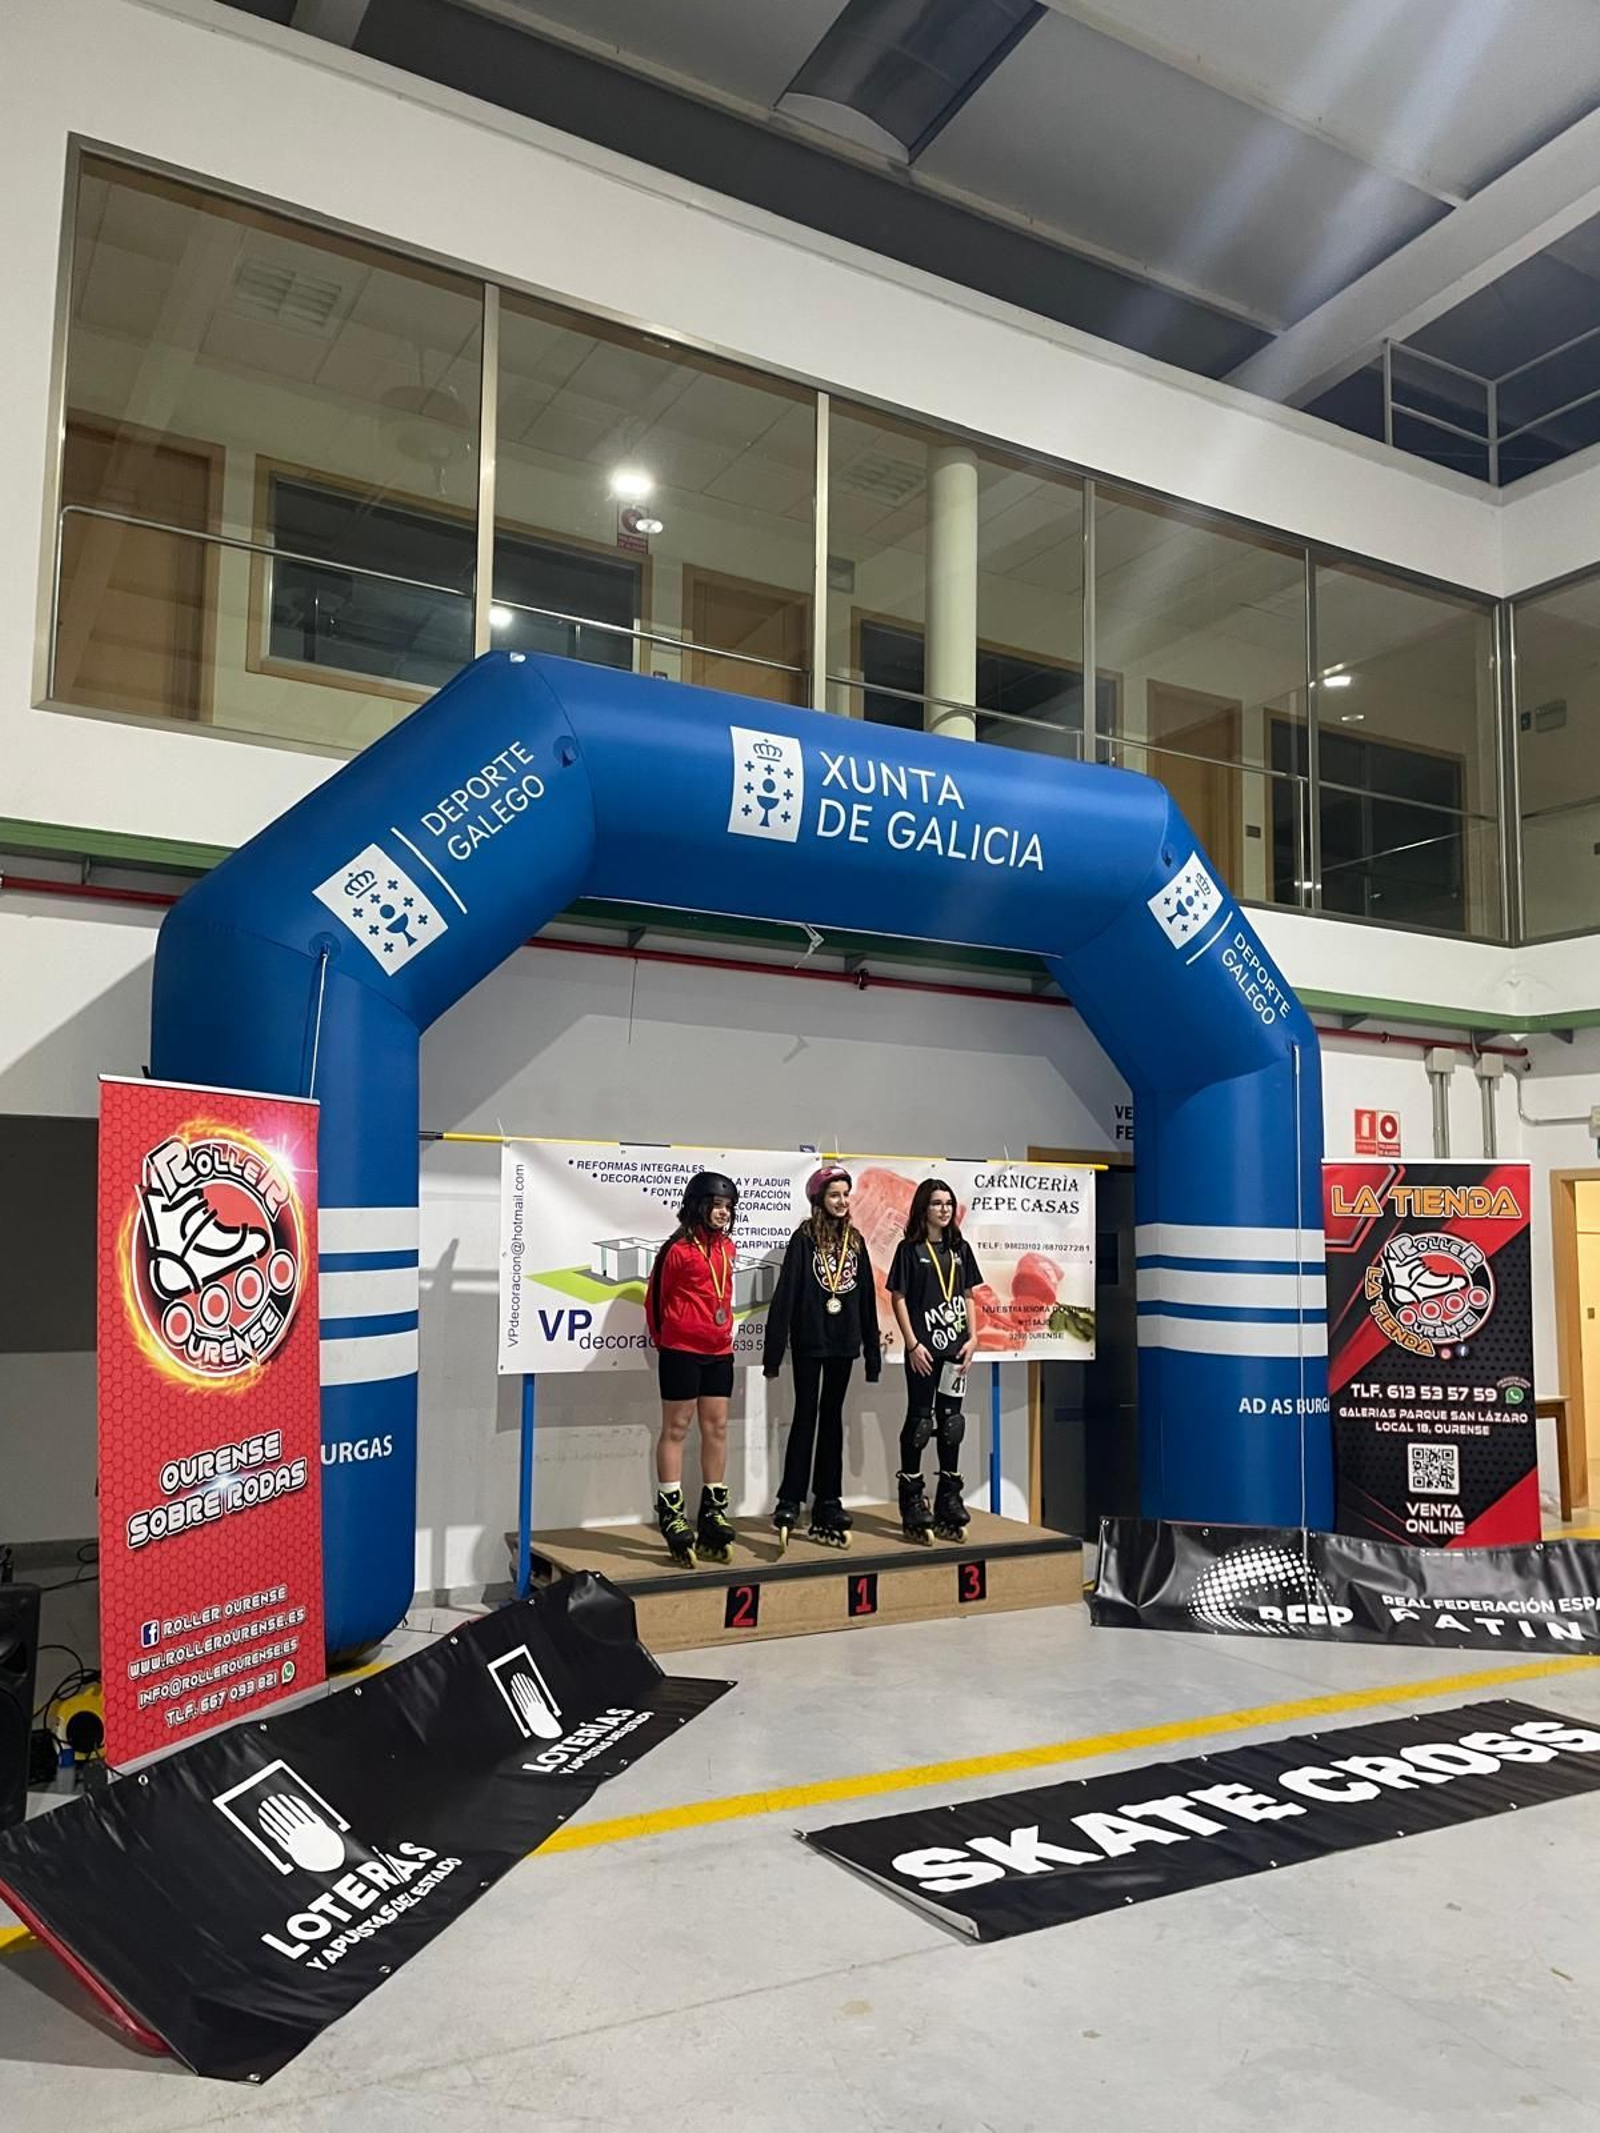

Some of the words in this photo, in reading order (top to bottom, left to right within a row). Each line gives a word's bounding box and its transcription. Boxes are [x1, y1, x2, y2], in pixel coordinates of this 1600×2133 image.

[421, 741, 534, 836] DEPORTE
[820, 751, 965, 810] XUNTA
[447, 775, 544, 860] GALEGO
[817, 798, 873, 843] DE
[887, 811, 1044, 871] GALICIA
[1221, 949, 1275, 1025] GALEGO
[1233, 932, 1291, 1018] DEPORTE
[1115, 1106, 1134, 1120] VE
[1115, 1125, 1134, 1140] FE
[150, 1138, 289, 1216] ROLLER
[577, 1160, 638, 1171] REFORMAS
[640, 1163, 705, 1173] INTEGRALES
[600, 1173, 671, 1184] DECORACIÓN
[674, 1176, 688, 1184] EN
[753, 1178, 790, 1187] PLADUR
[650, 1188, 684, 1197] FONTA
[738, 1189, 791, 1199] LEFACCIÓN
[971, 1196, 1017, 1211] PEPE
[1020, 1198, 1080, 1214] CASAS
[1332, 1185, 1383, 1217] LA
[1389, 1186, 1522, 1218] TIENDA
[732, 1227, 791, 1236] ECTRICIDAD
[1387, 1233, 1485, 1274] ROLLER
[1365, 1266, 1384, 1300] LA
[538, 1309, 593, 1342] VP
[738, 1324, 764, 1334] ROB
[1370, 1301, 1436, 1357] TIENDA
[1238, 1397, 1266, 1414] AD
[1271, 1398, 1293, 1415] AS
[1351, 1383, 1382, 1398] TLF.
[1387, 1384, 1416, 1399] 613
[1420, 1385, 1443, 1400] 53
[1447, 1386, 1469, 1401] 57
[1473, 1387, 1497, 1402] 59
[1339, 1407, 1396, 1418] GALERIAS
[1400, 1408, 1447, 1420] PARQUE
[1450, 1411, 1475, 1421] SAN
[1478, 1410, 1529, 1423] LÁZARO
[1375, 1421, 1414, 1432] LOCAL
[1434, 1423, 1490, 1435] OURENSE
[161, 1430, 281, 1493] OURENSE
[321, 1435, 393, 1465] URGAS
[128, 1495, 222, 1548] SOBRE
[226, 1459, 306, 1511] RODAS
[1405, 1502, 1464, 1519] VENTA
[1405, 1521, 1466, 1535] ONLINE
[855, 1577, 872, 1614] 1
[964, 1566, 981, 1600] 3
[163, 1606, 220, 1636] ROLLER
[225, 1585, 287, 1616] OURENSE
[732, 1587, 755, 1627] 2
[1381, 1594, 1431, 1609] REAL
[1433, 1597, 1555, 1614] FEDERACIÓN
[129, 1607, 305, 1678] WWW.ROLLEROURENSE.ES
[139, 1638, 298, 1707] INFO@ROLLEROURENSE.ES
[166, 1703, 198, 1727] TLF.
[201, 1691, 226, 1712] 667
[257, 1671, 278, 1690] 821
[522, 1708, 635, 1773] LOTERÍAS
[890, 1781, 1308, 1893] SKATE
[1278, 1721, 1600, 1803] CROSS
[306, 1957, 328, 1971] Y
[411, 1857, 463, 1897] ESTADO
